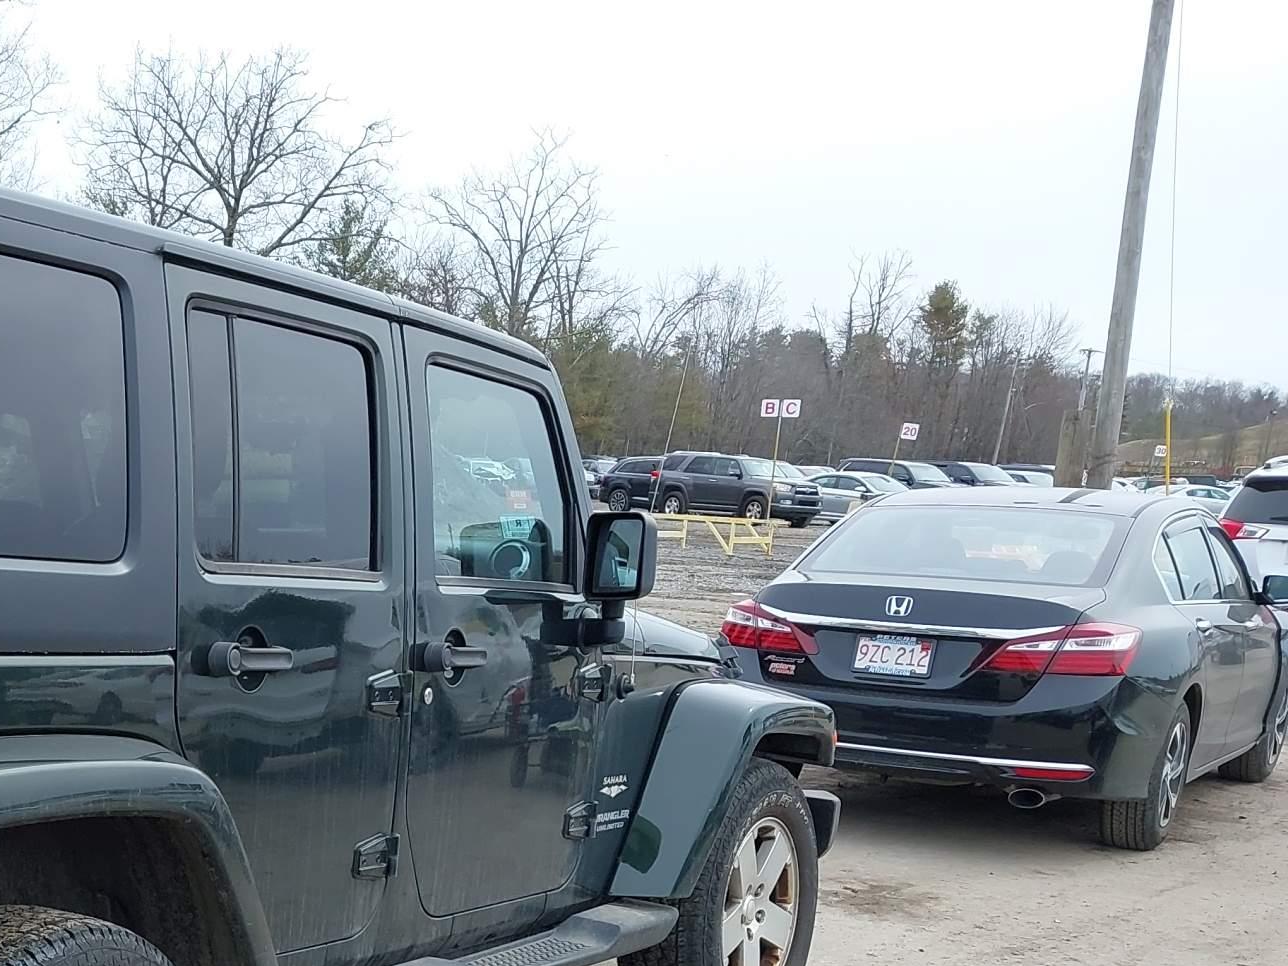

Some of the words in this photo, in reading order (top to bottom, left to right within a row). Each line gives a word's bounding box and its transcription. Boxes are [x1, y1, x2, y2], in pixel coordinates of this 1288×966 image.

[765, 402, 776, 415] B
[785, 402, 797, 415] C
[903, 426, 917, 437] 20
[857, 644, 891, 664] 9ZC
[894, 646, 929, 668] 212
[602, 774, 628, 785] SAHARA
